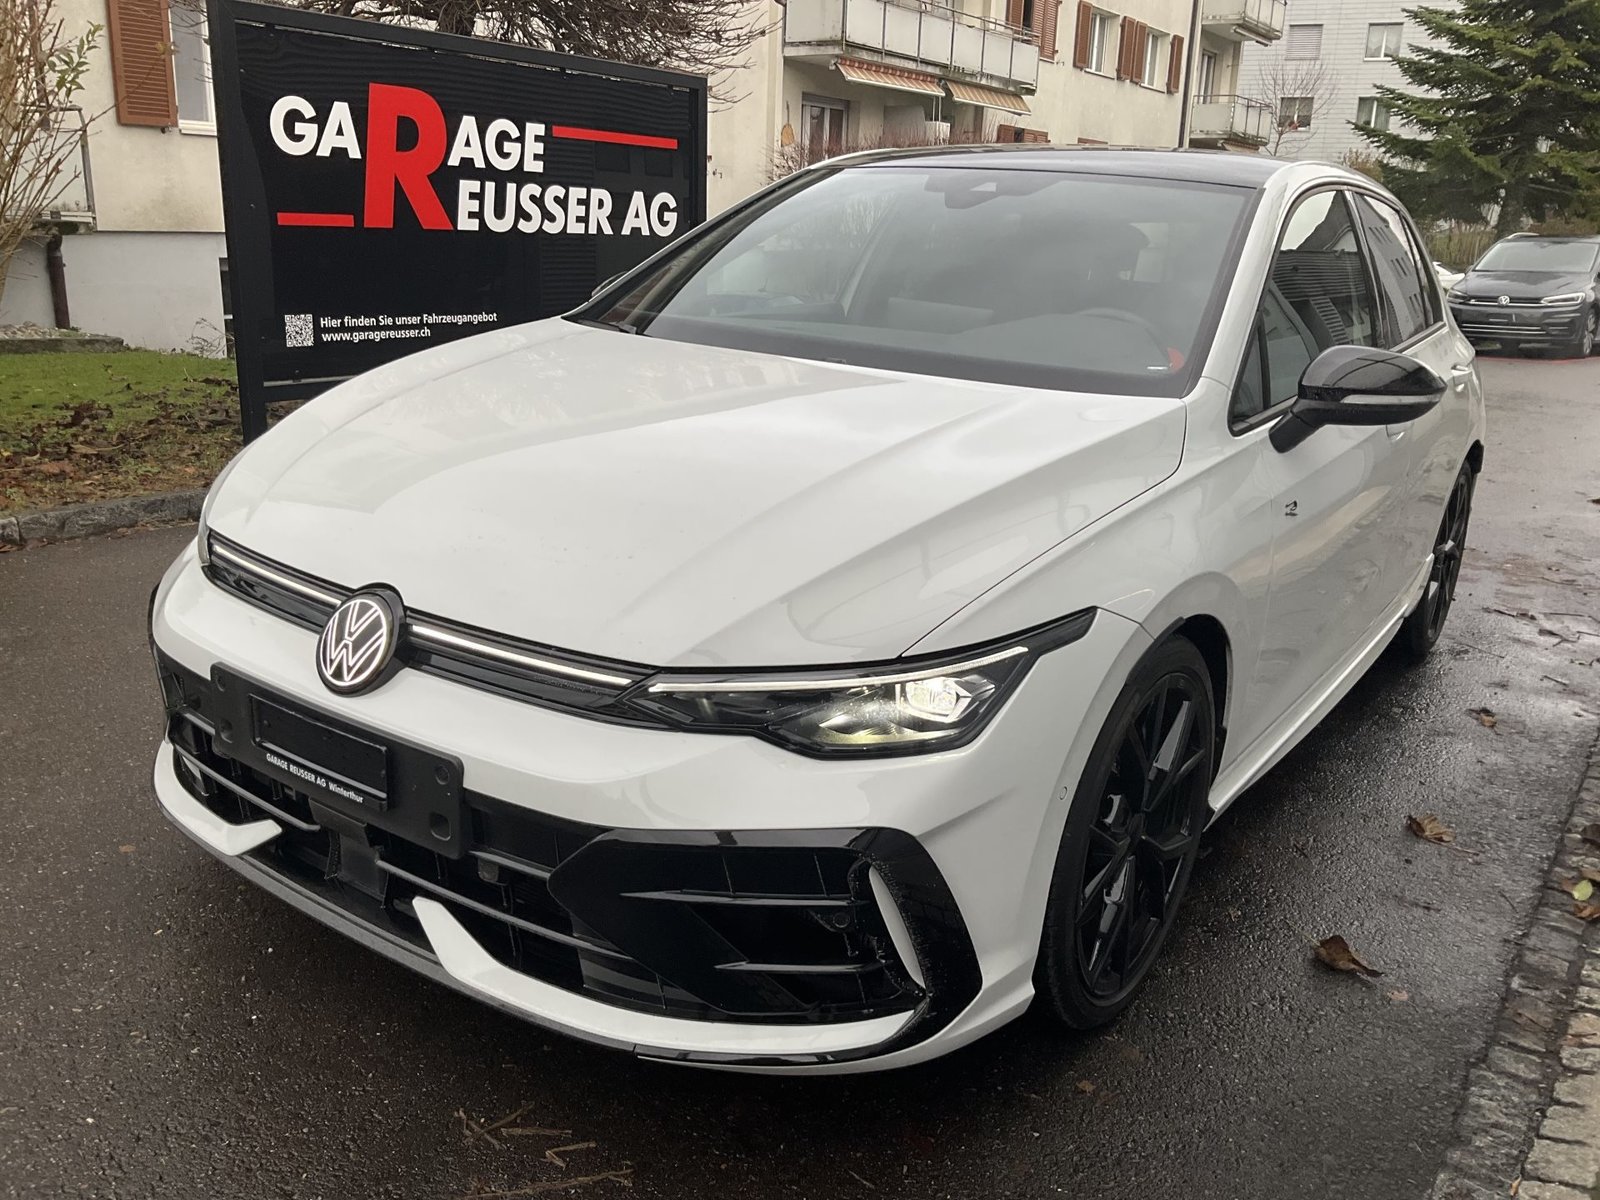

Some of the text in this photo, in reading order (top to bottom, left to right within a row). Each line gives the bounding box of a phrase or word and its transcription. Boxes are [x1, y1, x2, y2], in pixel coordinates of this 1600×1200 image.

[269, 82, 546, 230] GARAGE
[621, 190, 678, 237] AG
[320, 312, 498, 328] Hier finden Sie unser Fahrzeugangebot
[321, 327, 431, 343] www.garagereusser.ch
[266, 753, 364, 803] GARAGE REUSSER AG Winterthur
